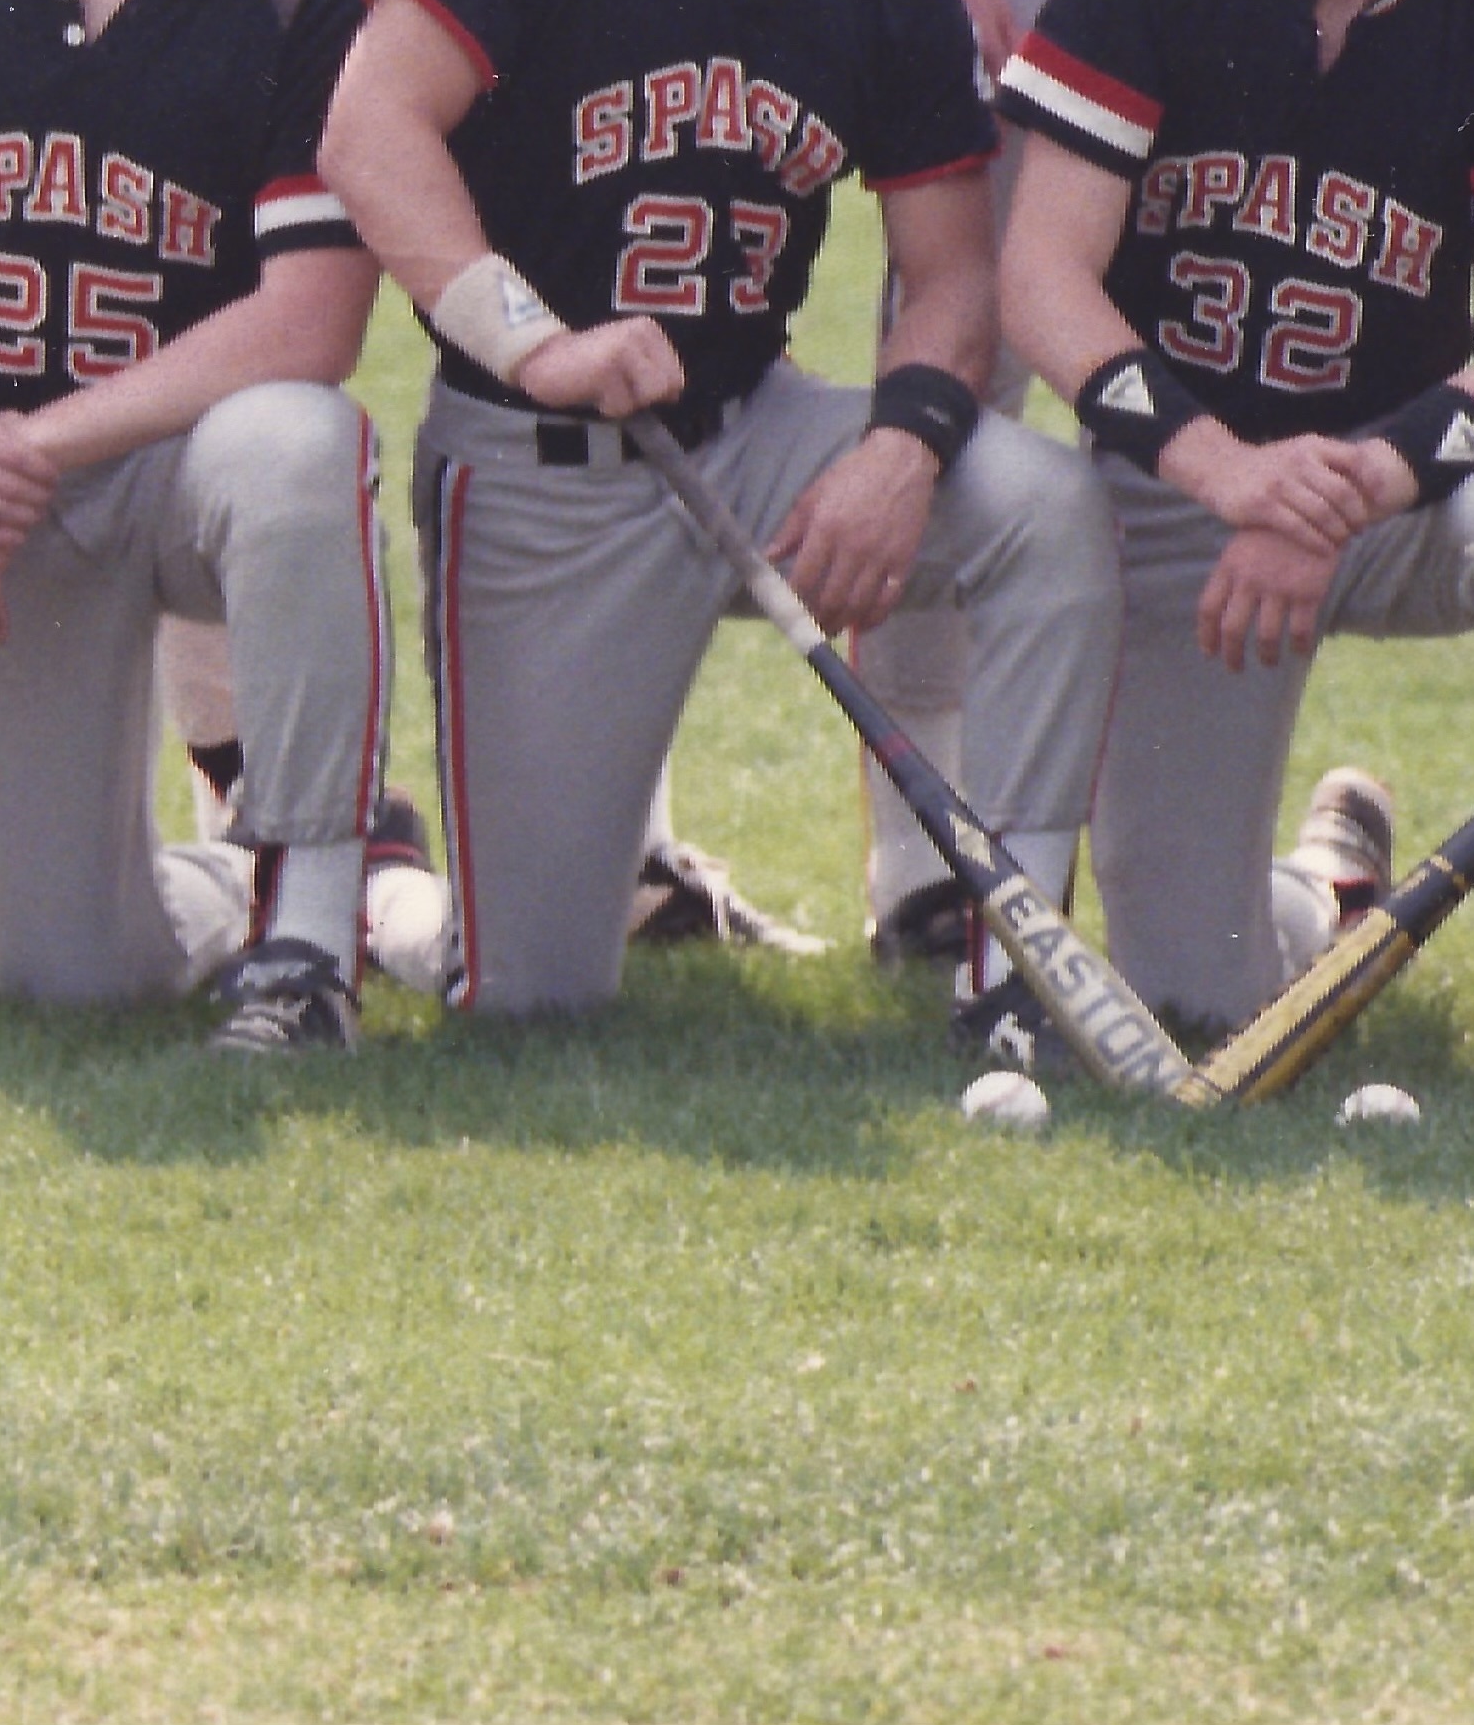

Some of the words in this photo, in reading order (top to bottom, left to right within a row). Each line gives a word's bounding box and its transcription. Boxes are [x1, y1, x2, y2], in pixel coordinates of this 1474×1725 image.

[574, 57, 846, 195] SPASH
[611, 194, 789, 316] 23
[1158, 251, 1363, 393] 32
[999, 887, 1186, 1097] EASTON
